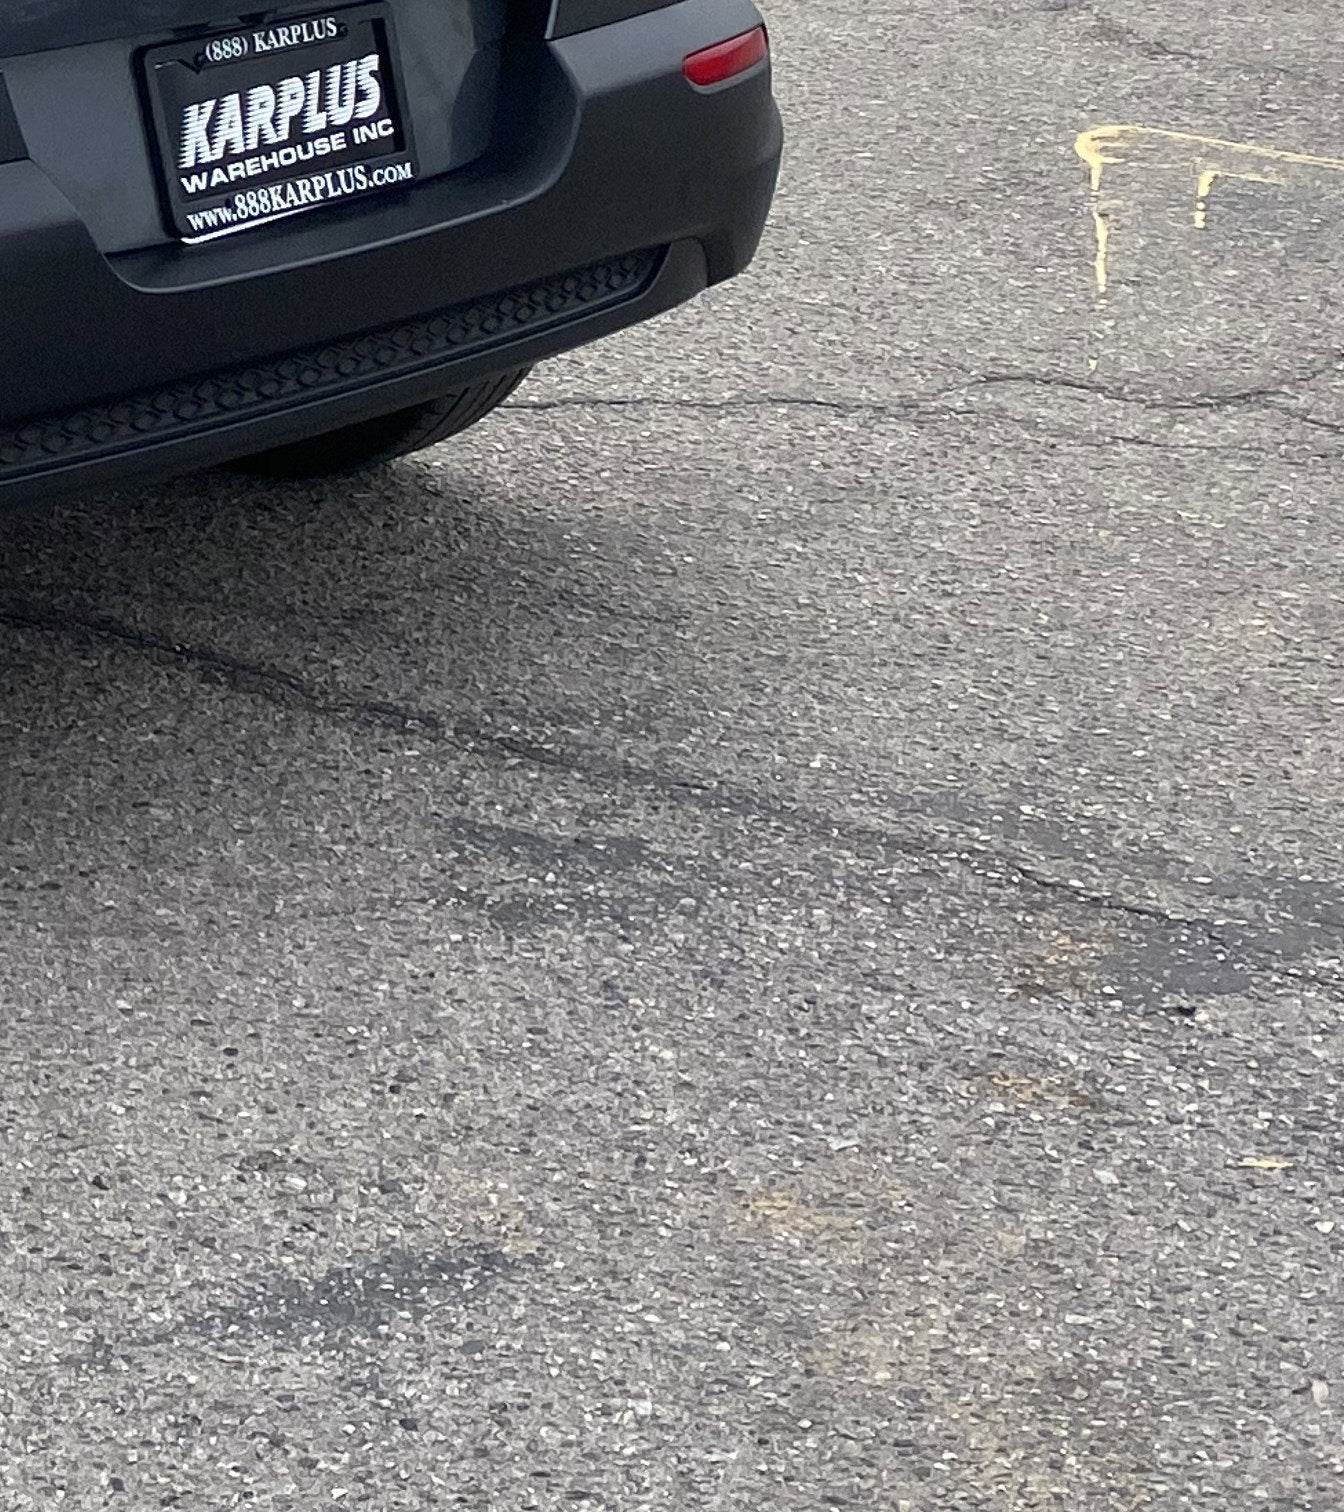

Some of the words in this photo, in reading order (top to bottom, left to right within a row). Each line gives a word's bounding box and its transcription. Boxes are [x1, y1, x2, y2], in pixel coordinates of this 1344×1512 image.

[205, 36, 249, 62] (888)
[253, 17, 338, 53] KARPLUS
[177, 54, 381, 169] KARPLUS
[180, 132, 347, 194] WAREHOUSE
[352, 118, 395, 145] INC
